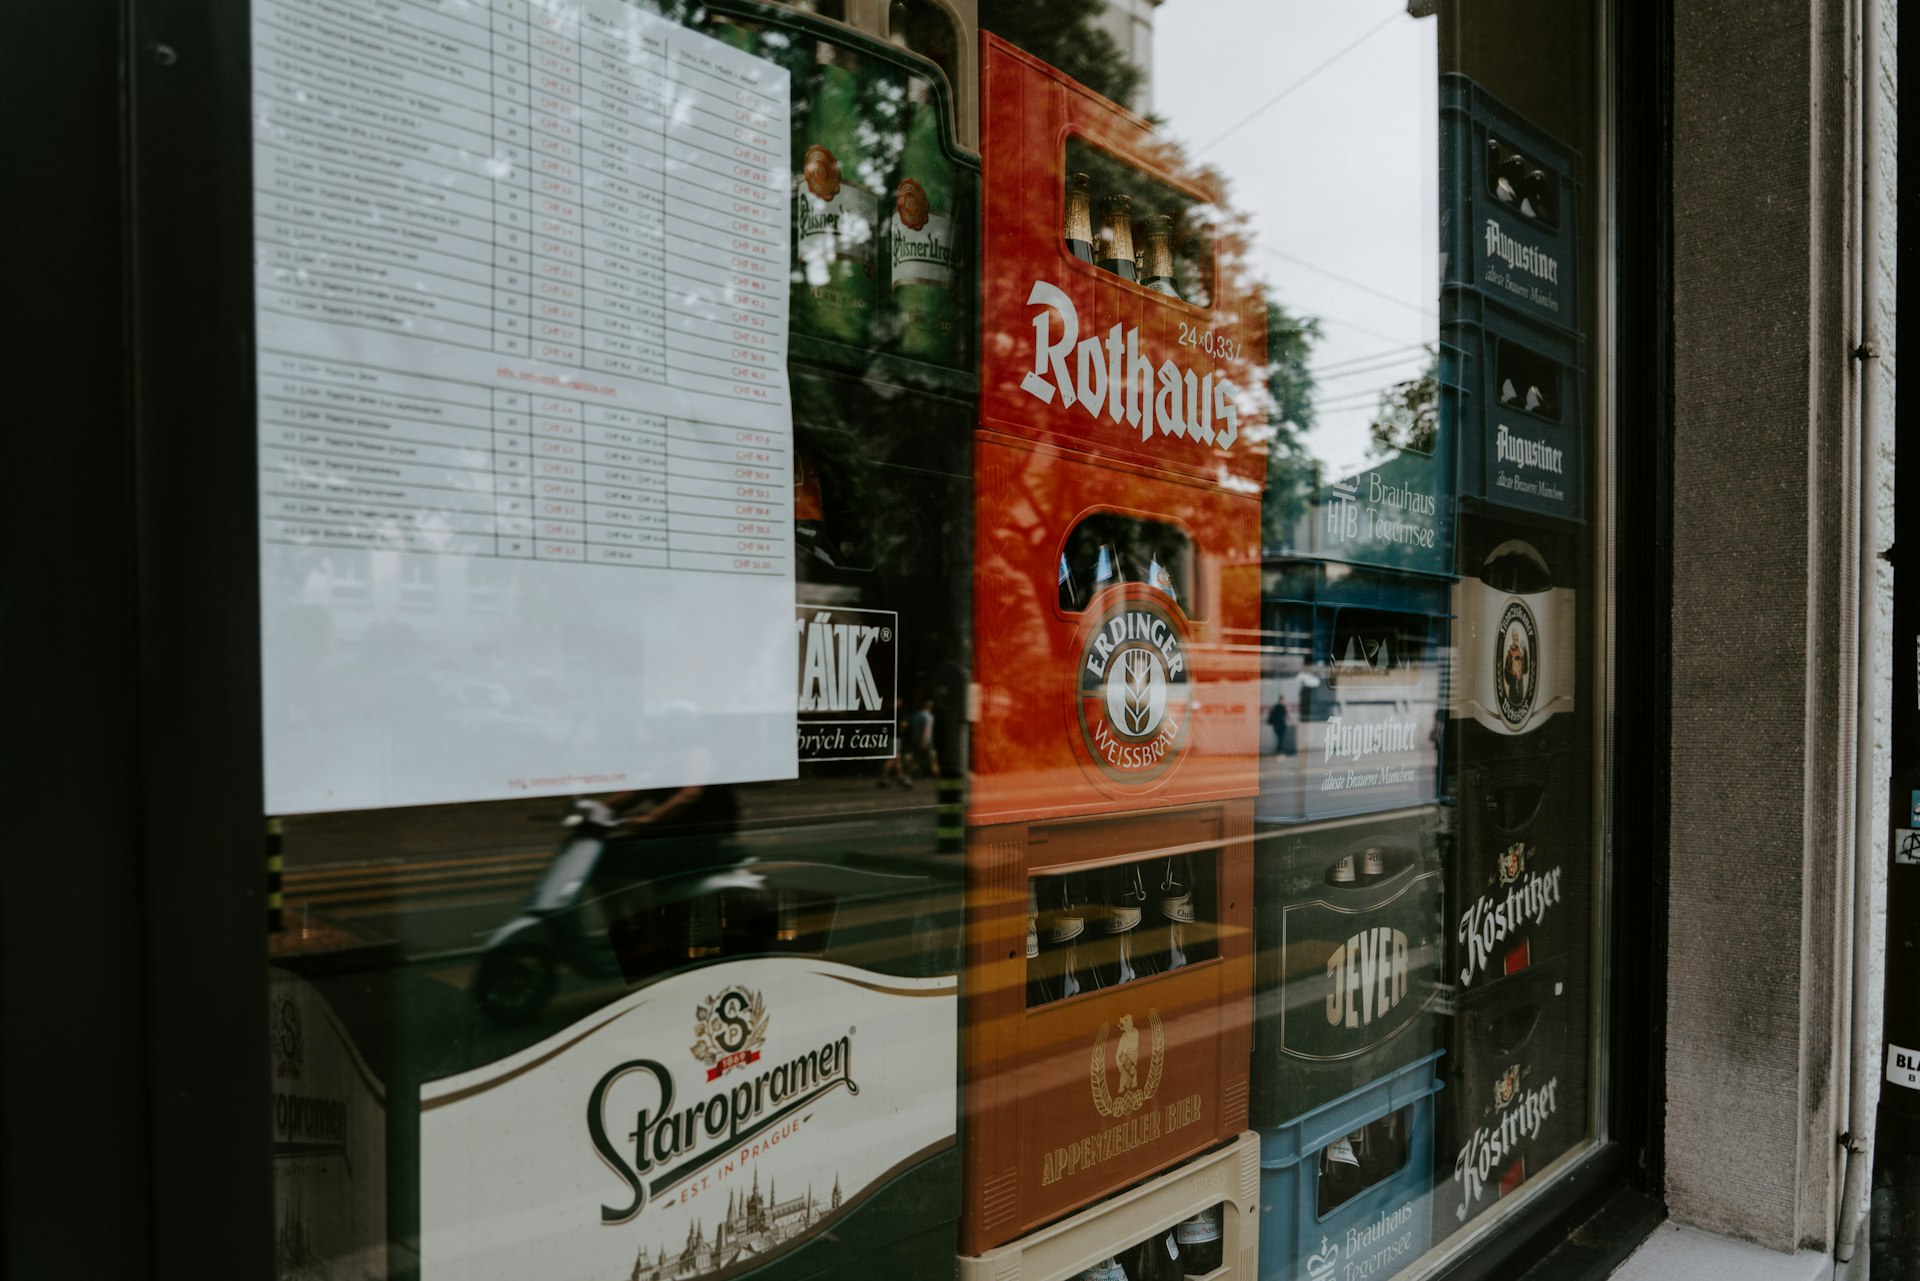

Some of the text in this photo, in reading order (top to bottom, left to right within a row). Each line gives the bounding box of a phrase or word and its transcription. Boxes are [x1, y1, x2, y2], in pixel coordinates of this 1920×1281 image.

[893, 225, 929, 267] Pilsner
[1485, 219, 1558, 285] Augustiner
[1019, 280, 1239, 451] Rothaus
[1496, 424, 1563, 475] Augustiner
[1369, 472, 1435, 517] Brauhaus
[1366, 508, 1435, 549] Tegernsee
[797, 612, 884, 711] ÁK
[1086, 612, 1184, 681] ERDINGER
[797, 727, 888, 755] brých časů
[1095, 716, 1179, 768] WEISSBRÄU
[1324, 716, 1417, 764] Augustiner
[1326, 927, 1409, 1029] JEVER
[721, 1052, 747, 1069] 1869
[587, 1034, 859, 1225] Staropramen
[1041, 1110, 1161, 1186] APPENZELLER
[1165, 1093, 1201, 1134] BIER
[680, 1119, 800, 1204] EST. IN PRAGUE
[1343, 1231, 1412, 1281] Tegernsee
[1345, 1201, 1412, 1260] Brauhaus
